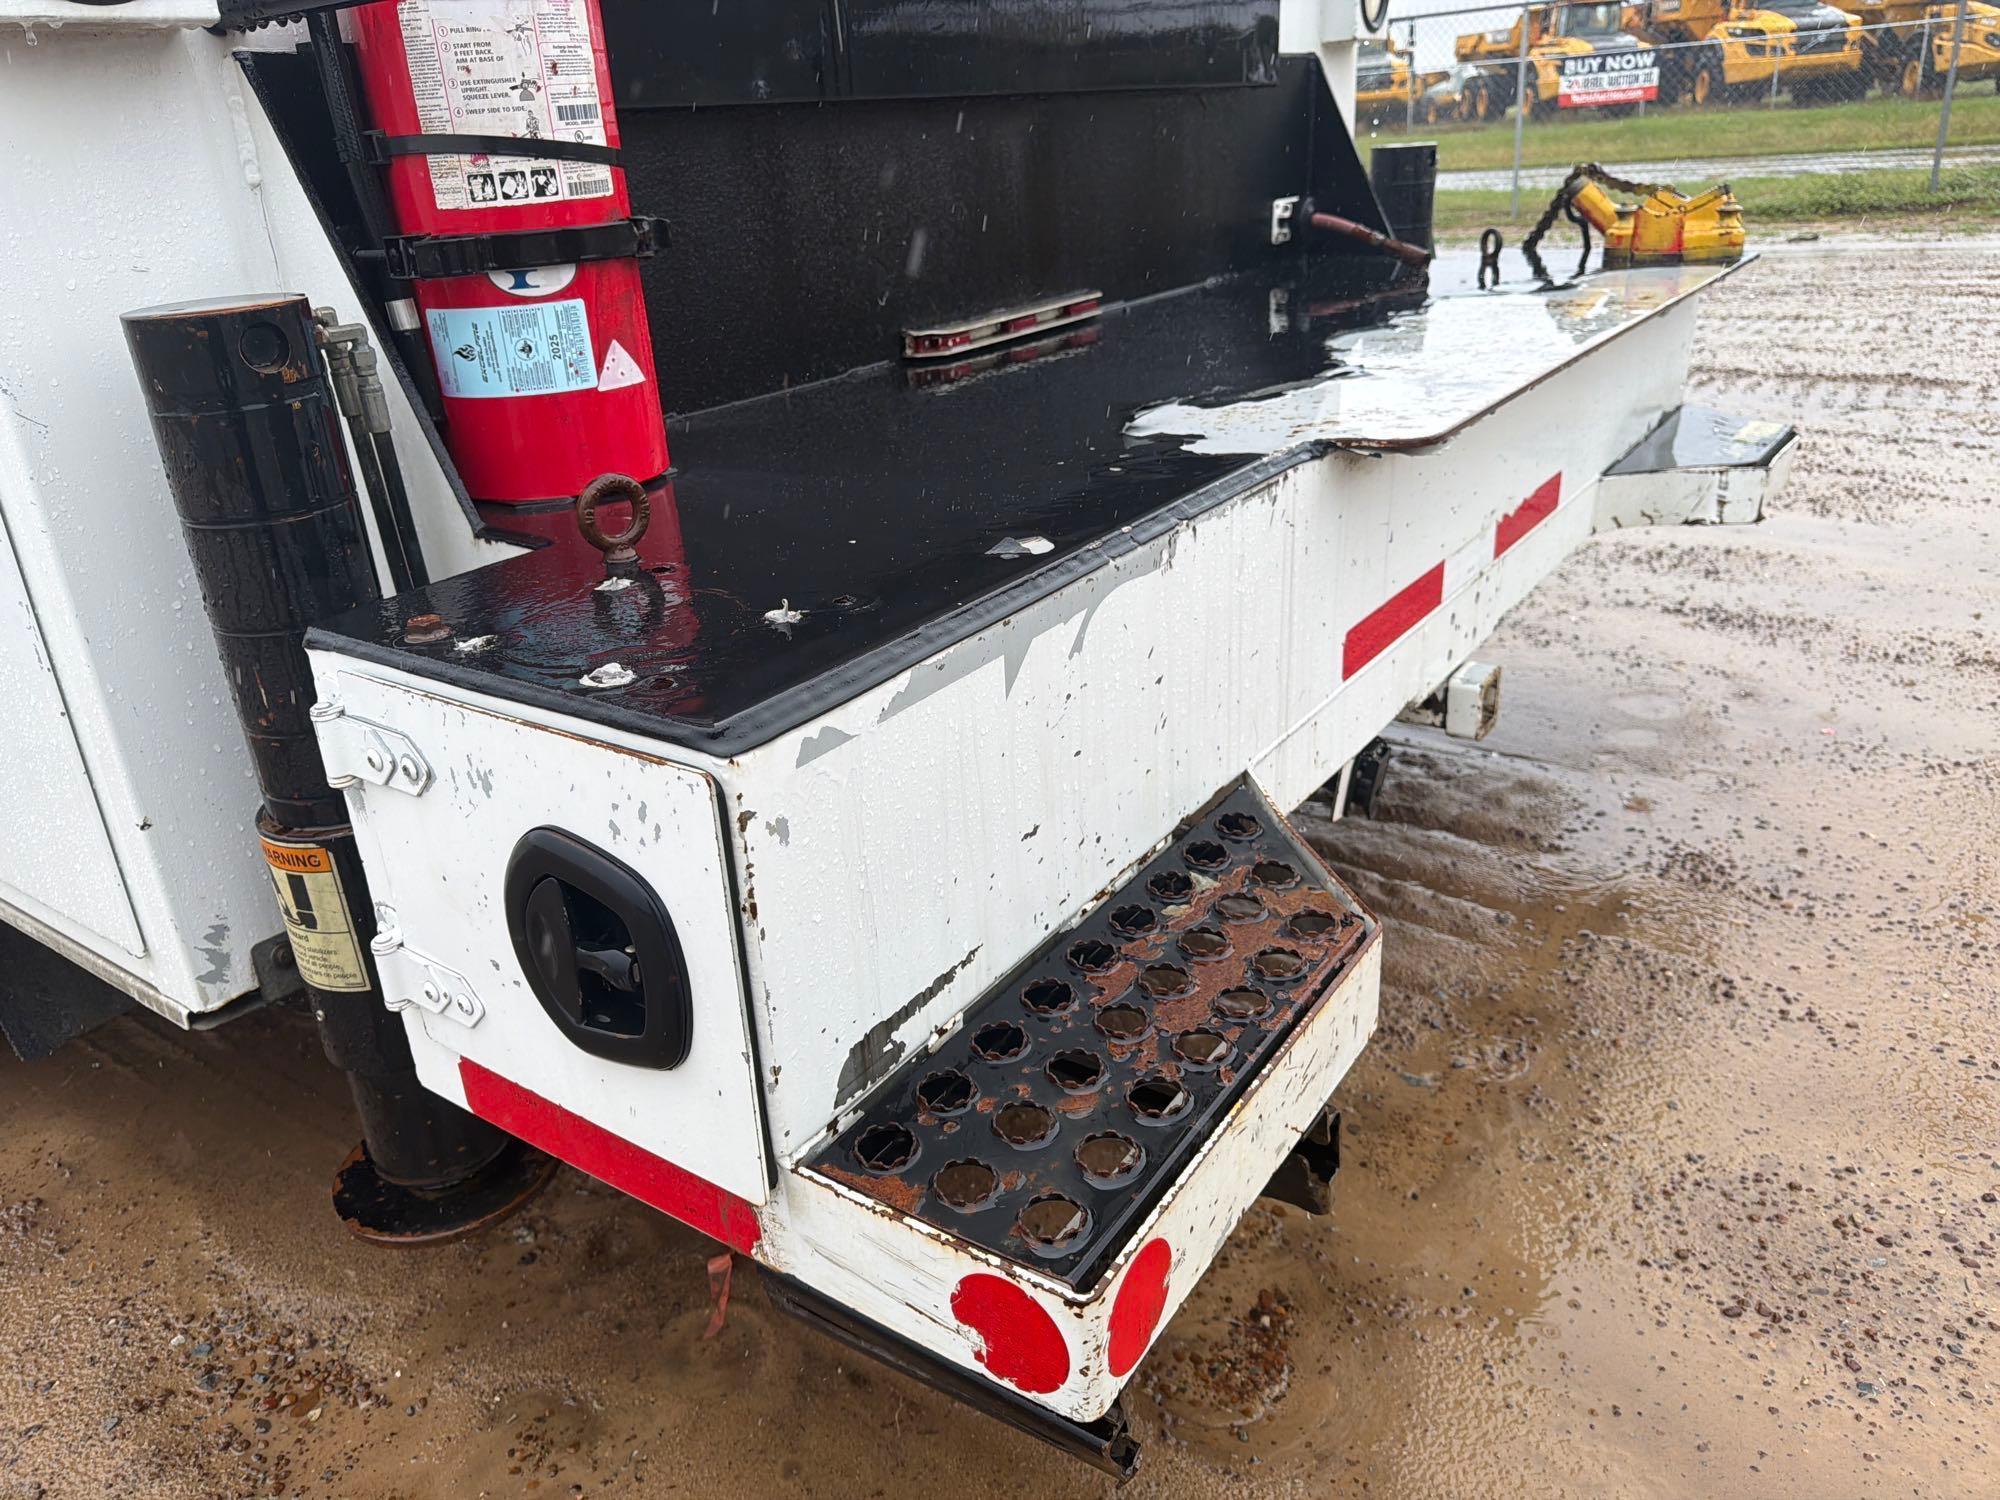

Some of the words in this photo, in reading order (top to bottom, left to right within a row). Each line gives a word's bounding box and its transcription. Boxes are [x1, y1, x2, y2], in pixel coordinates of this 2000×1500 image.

[453, 41, 471, 49] START
[473, 41, 491, 49] FROM
[1564, 57, 1602, 76] BUY
[1604, 51, 1656, 71] NOW
[460, 79, 471, 87] USE
[472, 77, 516, 86] EXTINGUISHER
[461, 86, 490, 94] UPRIGHT.
[462, 93, 489, 101] SQUEEZE
[465, 108, 485, 116] SWEEP
[549, 334, 561, 360] 2025
